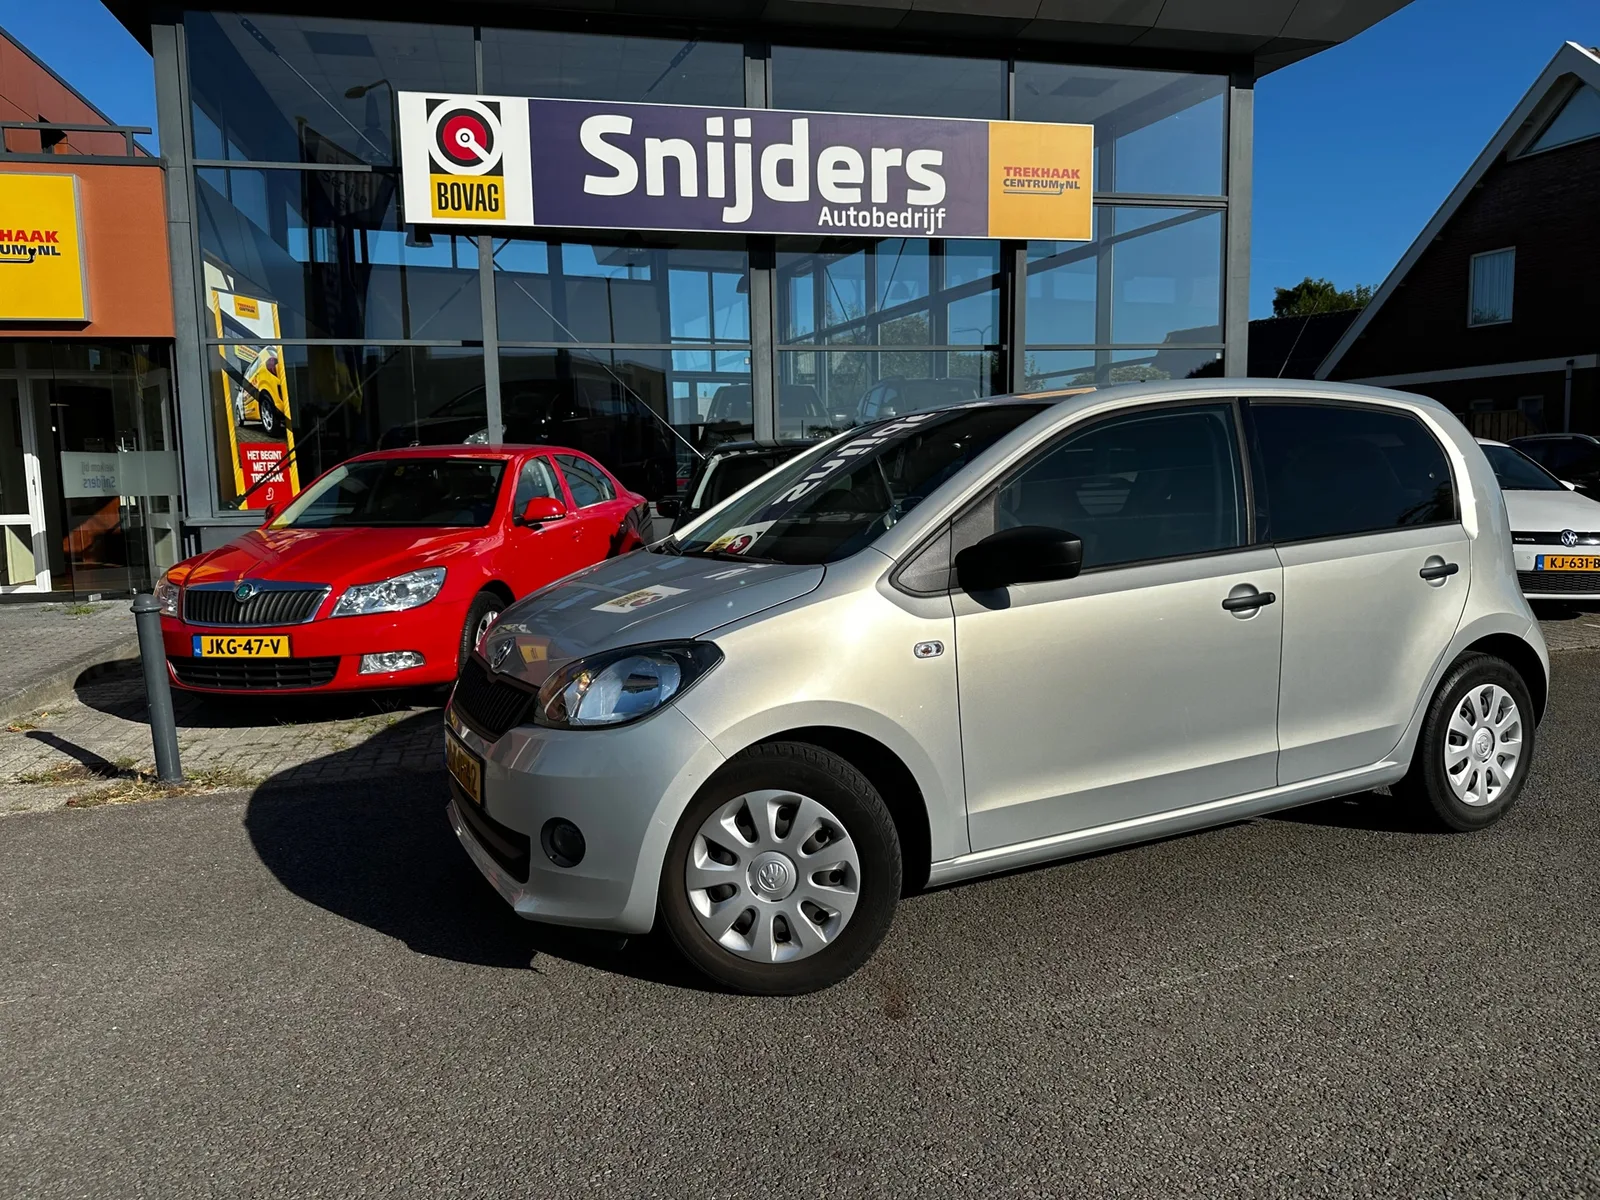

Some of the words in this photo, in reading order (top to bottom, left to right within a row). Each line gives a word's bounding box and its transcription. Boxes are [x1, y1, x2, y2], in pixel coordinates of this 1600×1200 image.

[580, 114, 946, 223] Snijders
[1003, 166, 1080, 179] TREKHAAK
[437, 182, 499, 212] BOVAG
[818, 206, 946, 235] Autobedrijf
[246, 450, 260, 460] HET
[260, 450, 282, 460] BEGINT
[253, 462, 267, 471] MET
[1550, 557, 1600, 569] KJ-631-B
[206, 638, 281, 655] JKG-47-V
